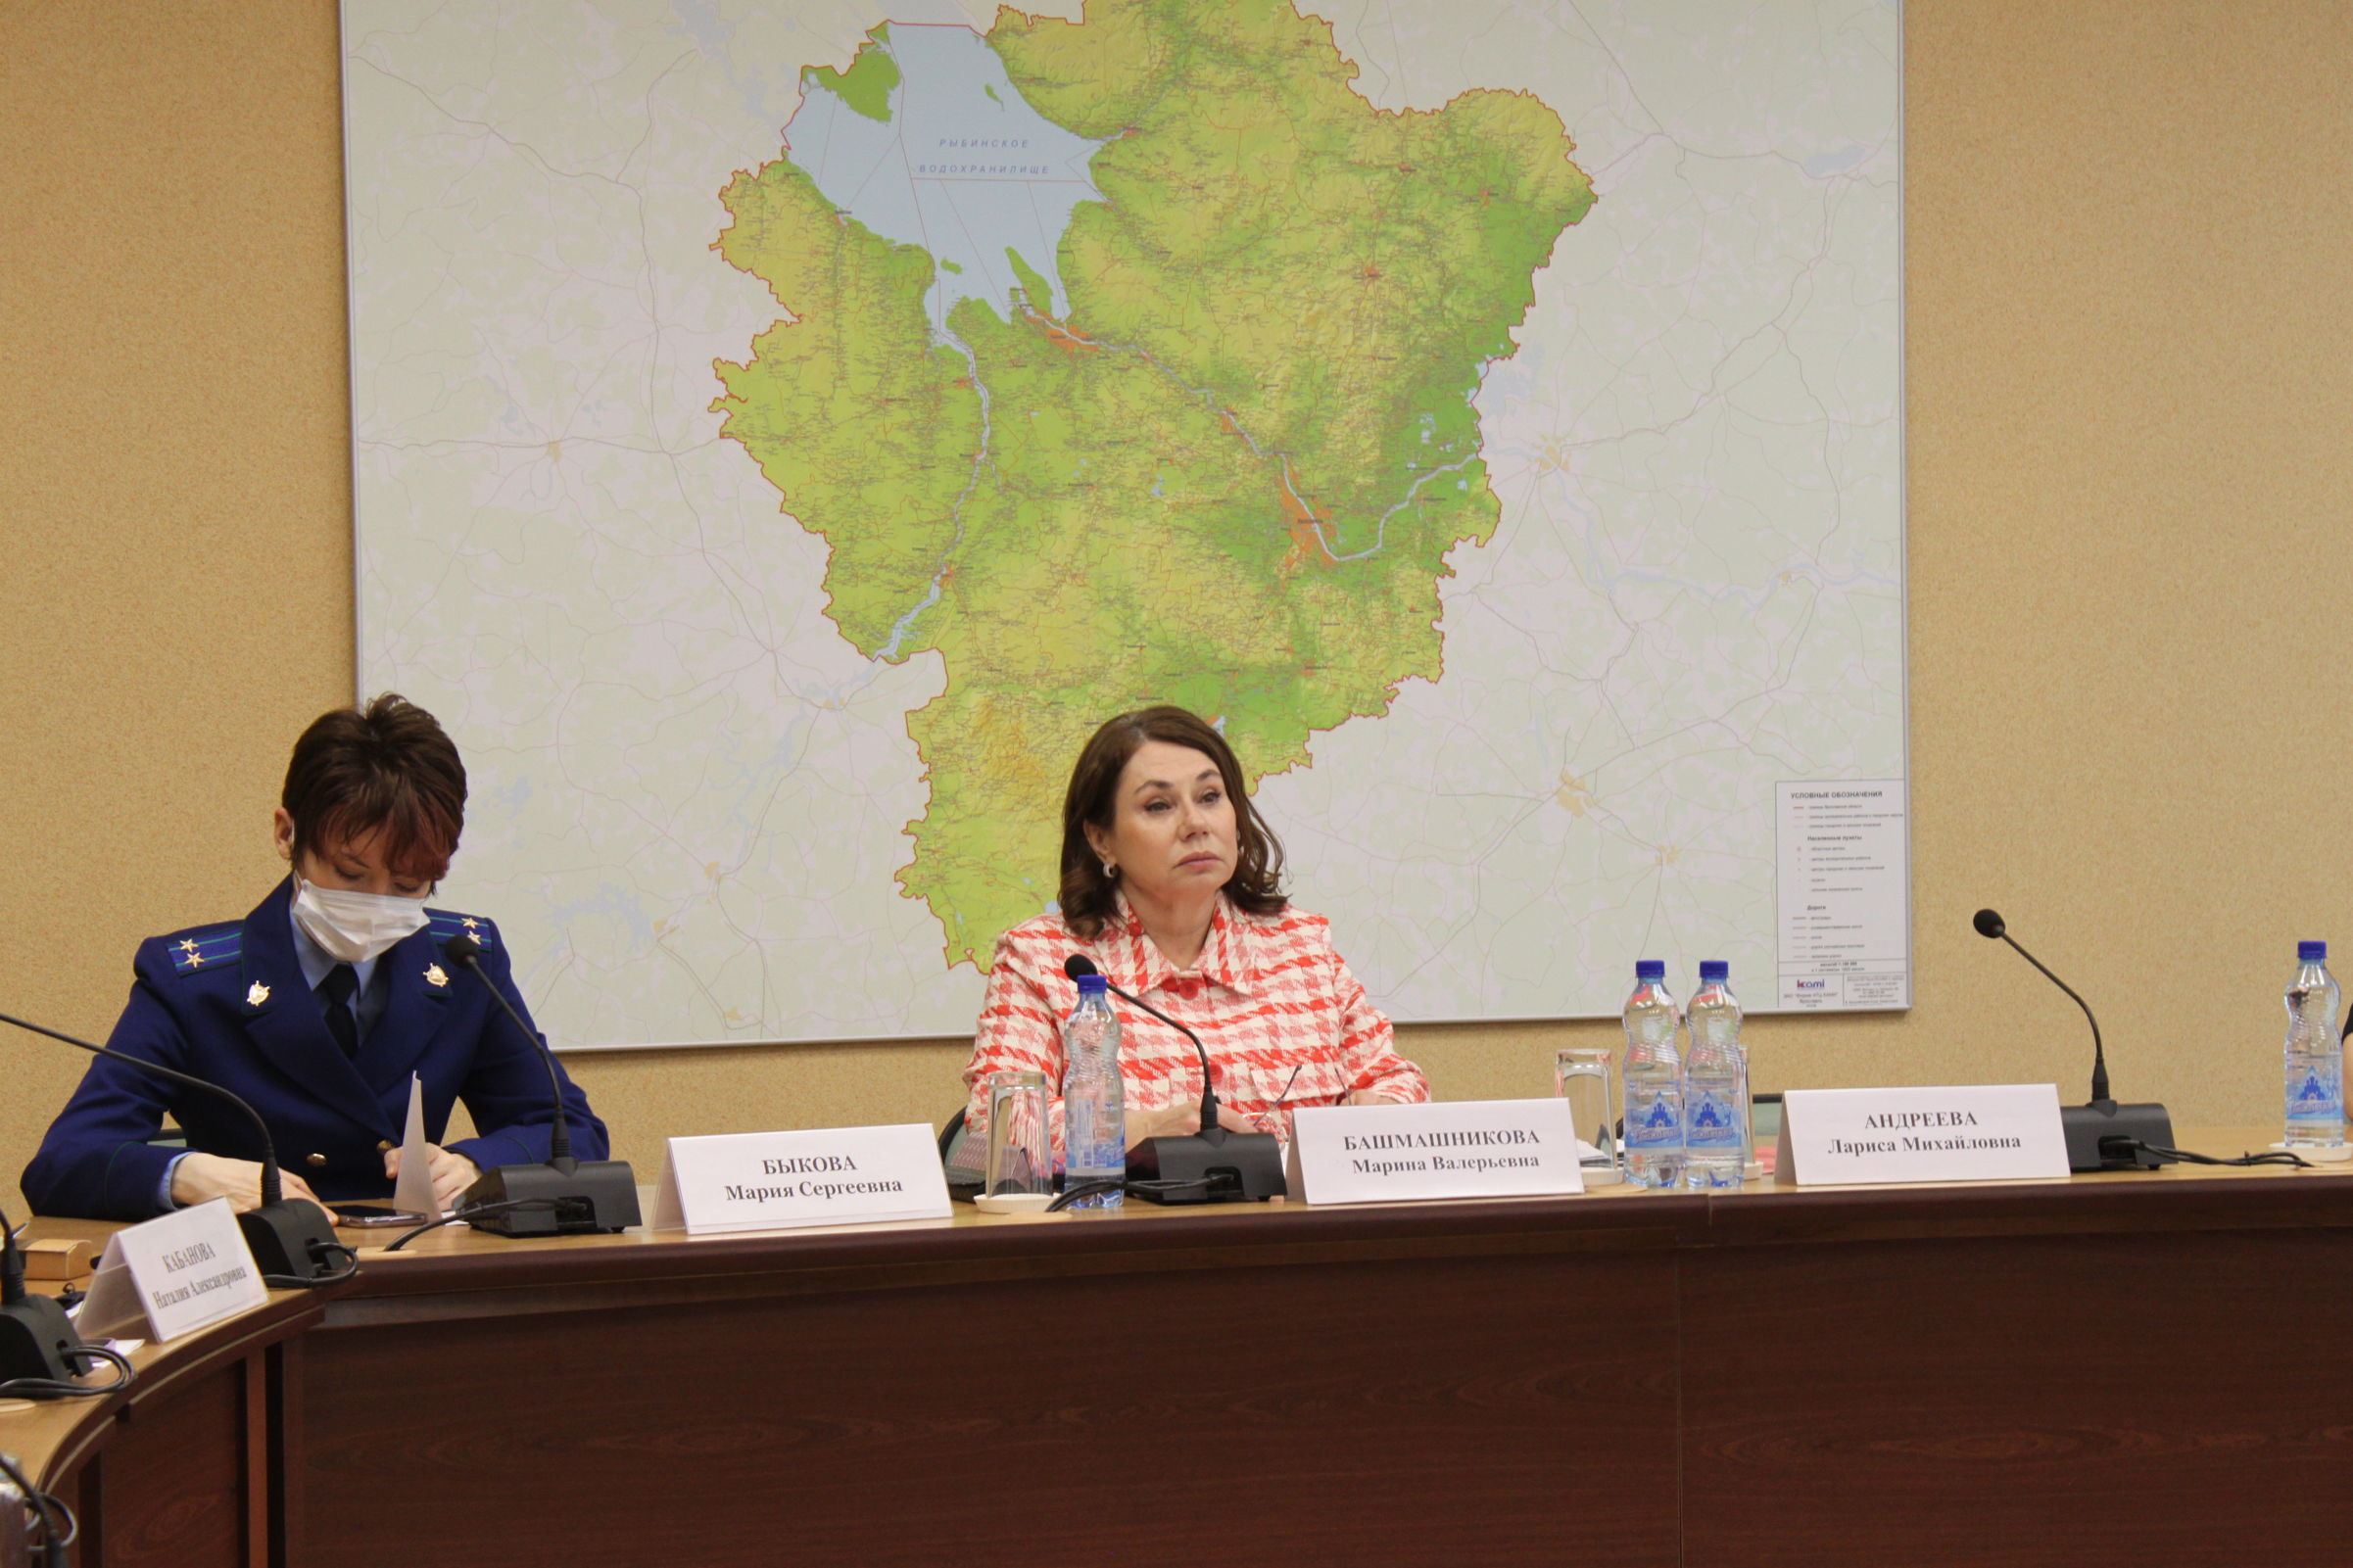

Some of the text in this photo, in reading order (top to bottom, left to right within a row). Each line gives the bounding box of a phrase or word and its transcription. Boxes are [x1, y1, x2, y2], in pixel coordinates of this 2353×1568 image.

[939, 139, 1029, 148] РЫБИНСКОЕ
[919, 165, 1050, 174] ВОДОХРАНИЛИЩЕ
[1865, 1111, 1978, 1130] АНДРЕЕВА
[1343, 1129, 1541, 1151] БАШМАШНИКОВА
[1828, 1134, 2022, 1157] Лариса Михайловна
[762, 1155, 858, 1175] БЫКОВА
[1352, 1155, 1540, 1176] Марина Валерьевна
[725, 1179, 903, 1203] Мария Сергеевна
[162, 1241, 216, 1273] КАБАНОВА
[189, 1265, 247, 1297] Александровна
